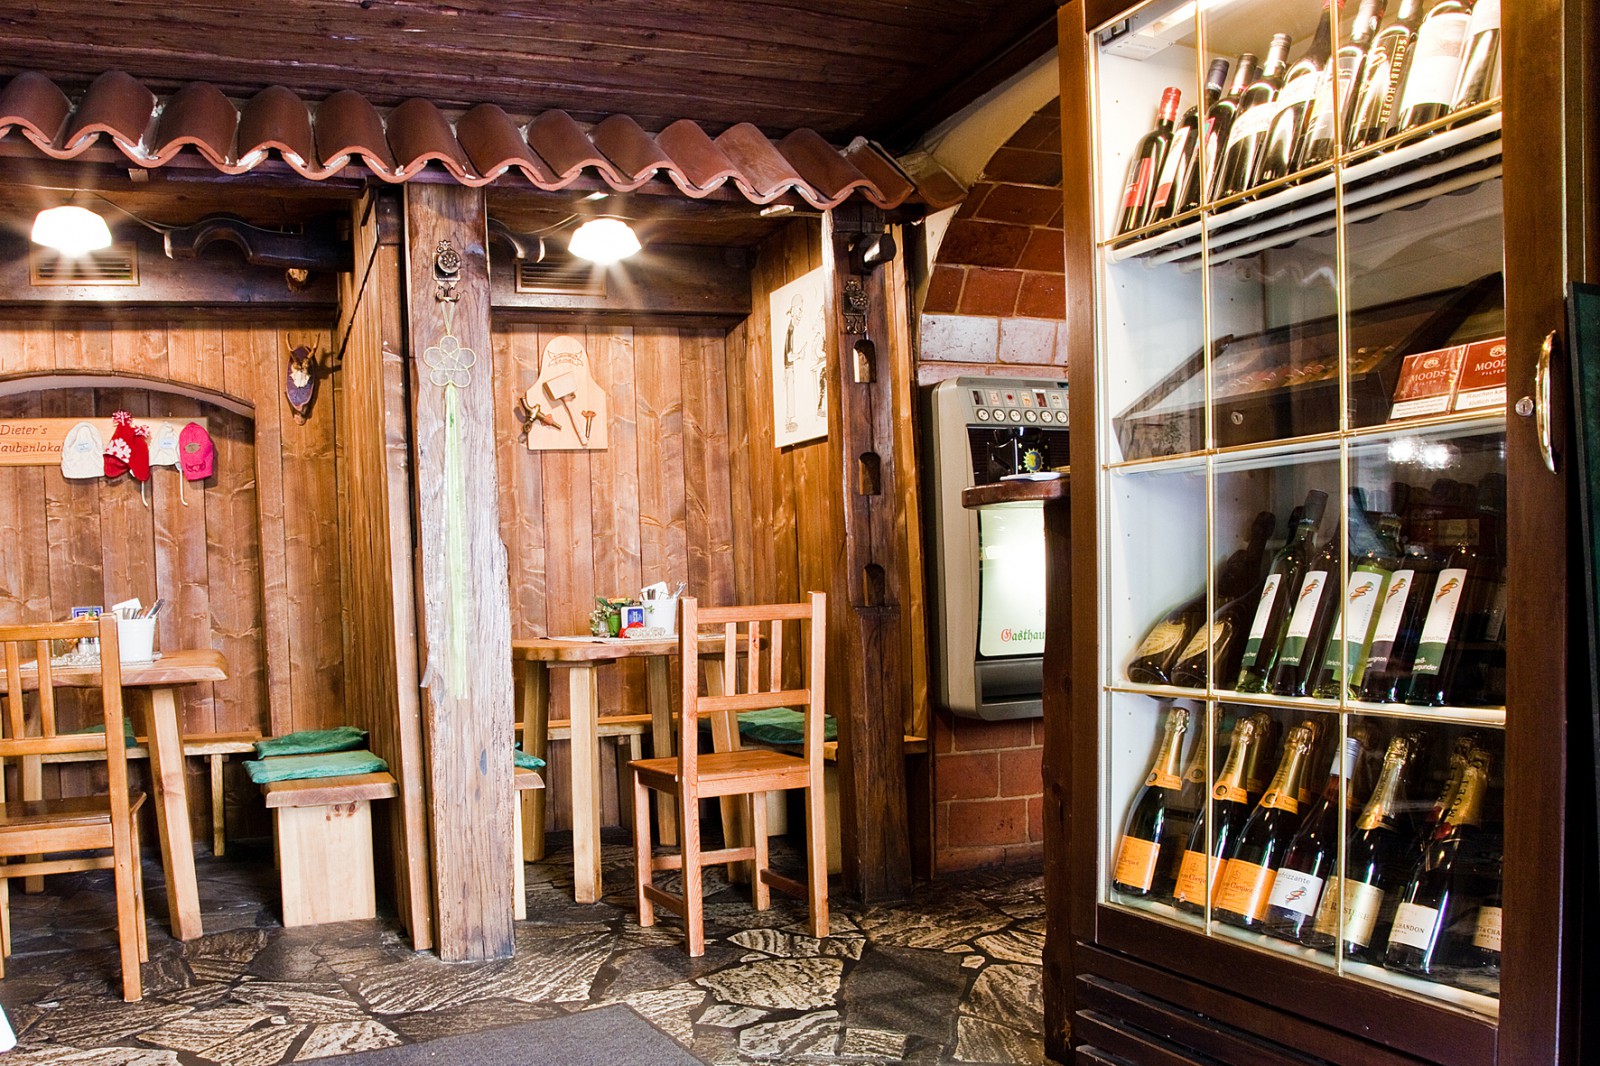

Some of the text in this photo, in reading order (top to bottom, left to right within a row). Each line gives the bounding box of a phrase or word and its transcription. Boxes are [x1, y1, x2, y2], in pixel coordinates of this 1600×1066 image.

[1410, 369, 1447, 382] MOODS
[0, 424, 48, 436] Dieter's
[0, 442, 64, 453] aubenlokal
